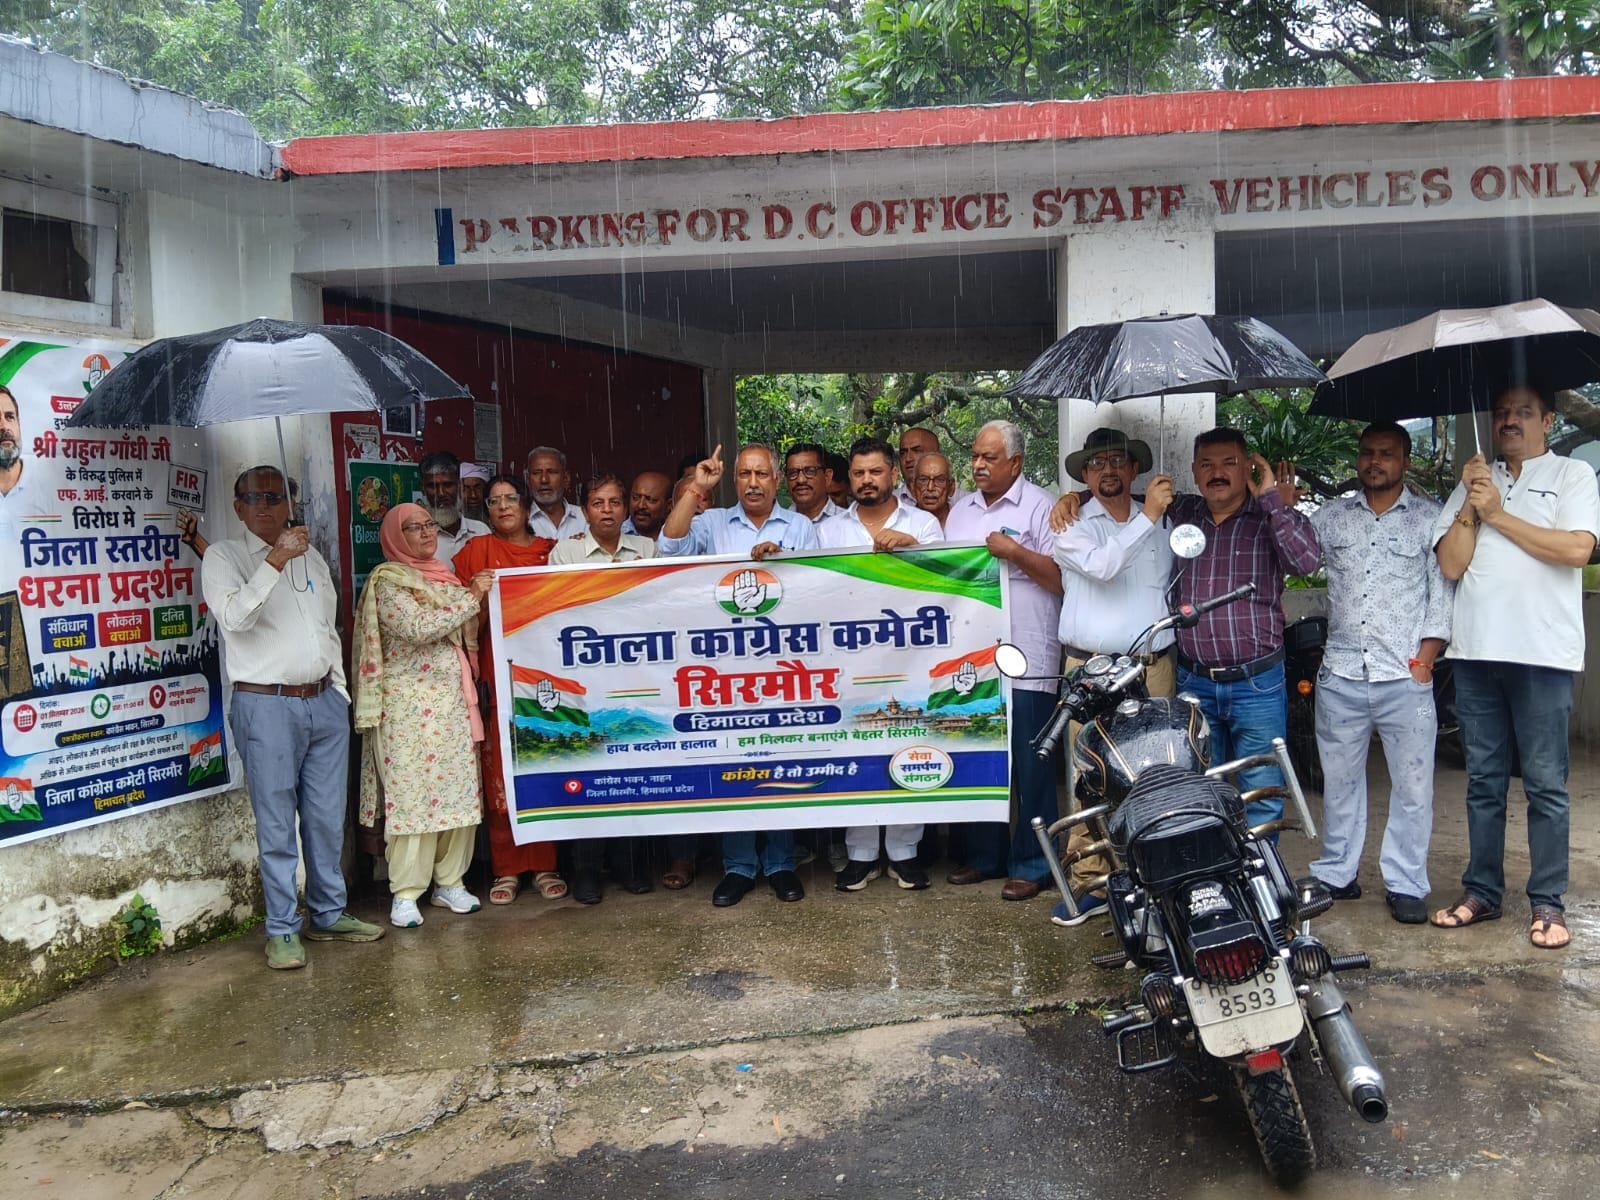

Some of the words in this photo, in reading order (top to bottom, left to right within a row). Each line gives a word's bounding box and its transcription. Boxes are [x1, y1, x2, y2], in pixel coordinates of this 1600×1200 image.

[655, 207, 750, 245] FOR
[850, 192, 1011, 237] OFFICE
[1033, 184, 1186, 229] STAFF
[1210, 166, 1452, 215] VEHICLES
[1470, 160, 1600, 201] ONLY
[33, 430, 57, 458] श्री
[61, 437, 106, 466] राहुल
[110, 432, 149, 461] गाँधी
[151, 436, 171, 462] जी
[65, 466, 76, 481] के
[79, 467, 106, 482] विरुद्ध
[108, 468, 134, 485] पुलिस
[135, 471, 143, 482] में
[175, 469, 199, 490] FIR
[57, 488, 81, 501] एफ.
[84, 485, 108, 503] आई.
[111, 488, 141, 501] करवाने
[143, 488, 153, 501] के
[170, 488, 190, 501] वापस
[191, 491, 201, 505] लो
[72, 505, 119, 530] विरोध
[20, 527, 98, 568] जिला
[104, 524, 181, 564] स्तरीय
[18, 572, 101, 609] धरना
[108, 559, 194, 604] प्रदर्शन
[106, 612, 143, 629] लोकतंत्र
[161, 608, 185, 623] दलित
[47, 617, 88, 635] संविधान
[109, 627, 141, 642] बचाओ
[160, 622, 188, 636] बचाओ
[52, 632, 87, 649] बचाओ
[557, 625, 677, 667] जिला
[688, 616, 821, 658] कांग्रेस
[829, 605, 951, 651] कमेटी
[673, 660, 840, 708] सिरमौर
[690, 713, 775, 731] हिमाचल
[777, 708, 825, 727] प्रदेश
[606, 743, 629, 754] हाथ
[633, 740, 676, 752] बदलेगा
[681, 738, 718, 751] हालात
[737, 736, 756, 747] हम
[760, 733, 804, 745] मिलकर
[807, 729, 848, 742] बनाएंगे
[851, 728, 884, 741] बेहतर
[887, 726, 928, 739] सिरमौर
[907, 750, 932, 761] सेवा
[721, 767, 771, 781] कांग्रेस
[773, 764, 784, 780] है
[786, 764, 803, 778] तो
[805, 762, 845, 777] उम्मीद
[847, 761, 858, 776] है
[900, 760, 942, 772] समर्पण
[45, 788, 76, 807] जिला
[77, 778, 113, 799] कांग्रेस
[115, 768, 145, 790] कमेटी
[147, 761, 183, 783] सिरमौर
[594, 775, 621, 785] कांग्रेस
[649, 774, 673, 783] नाहन
[903, 772, 941, 783] संगठन
[94, 793, 126, 810] हिमाचल
[127, 789, 145, 802] प्रदेश
[586, 788, 607, 798] जिला
[640, 785, 673, 796] हिमाचल
[675, 784, 695, 793] प्रदेश
[1219, 987, 1276, 1017] 8593
